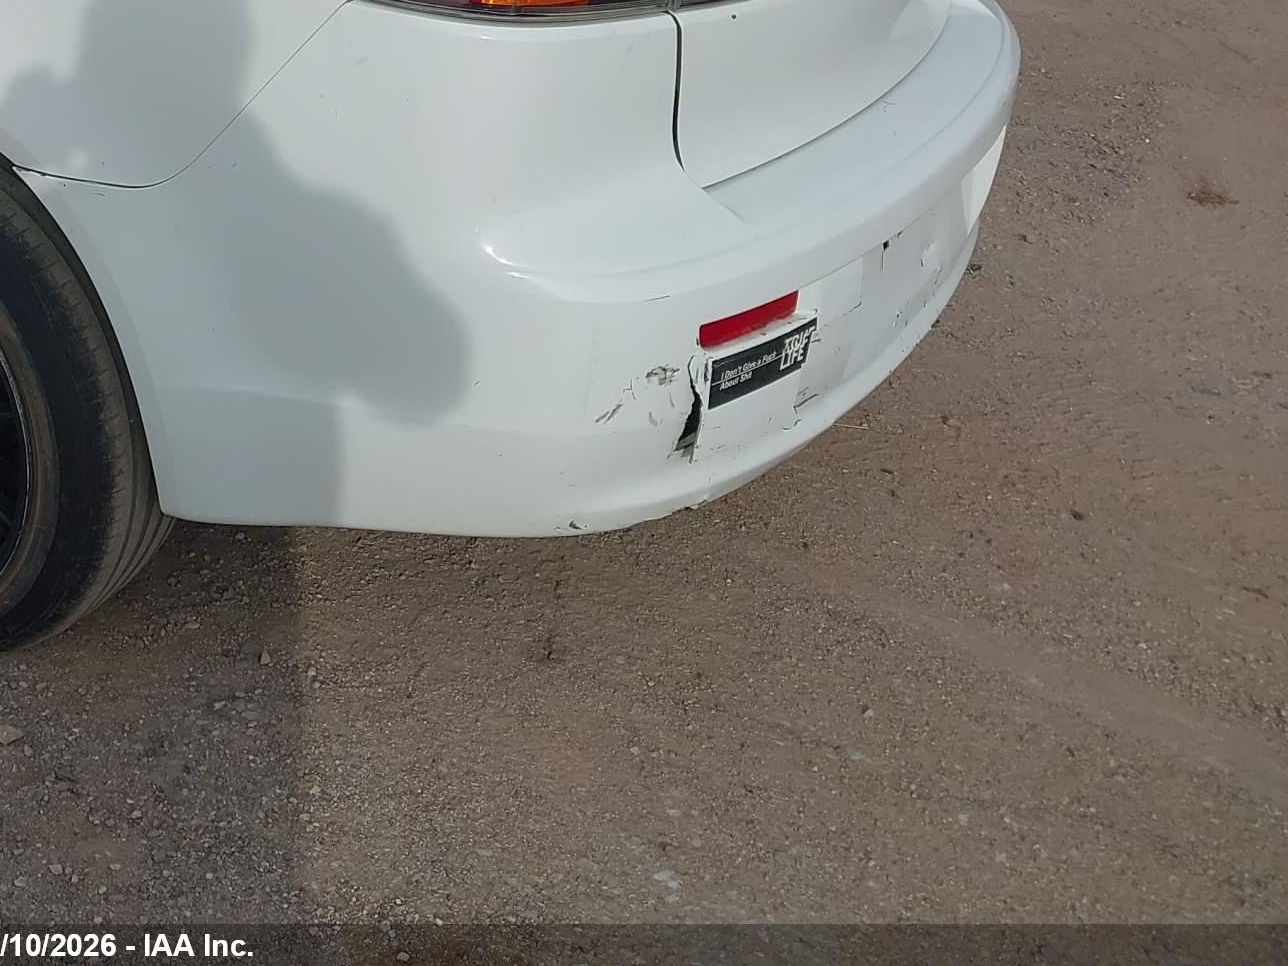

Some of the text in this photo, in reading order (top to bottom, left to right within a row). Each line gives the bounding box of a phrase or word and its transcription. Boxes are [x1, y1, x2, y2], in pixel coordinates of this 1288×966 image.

[742, 360, 757, 372] Give
[780, 347, 804, 370] LIFE
[720, 372, 752, 391] About Shit
